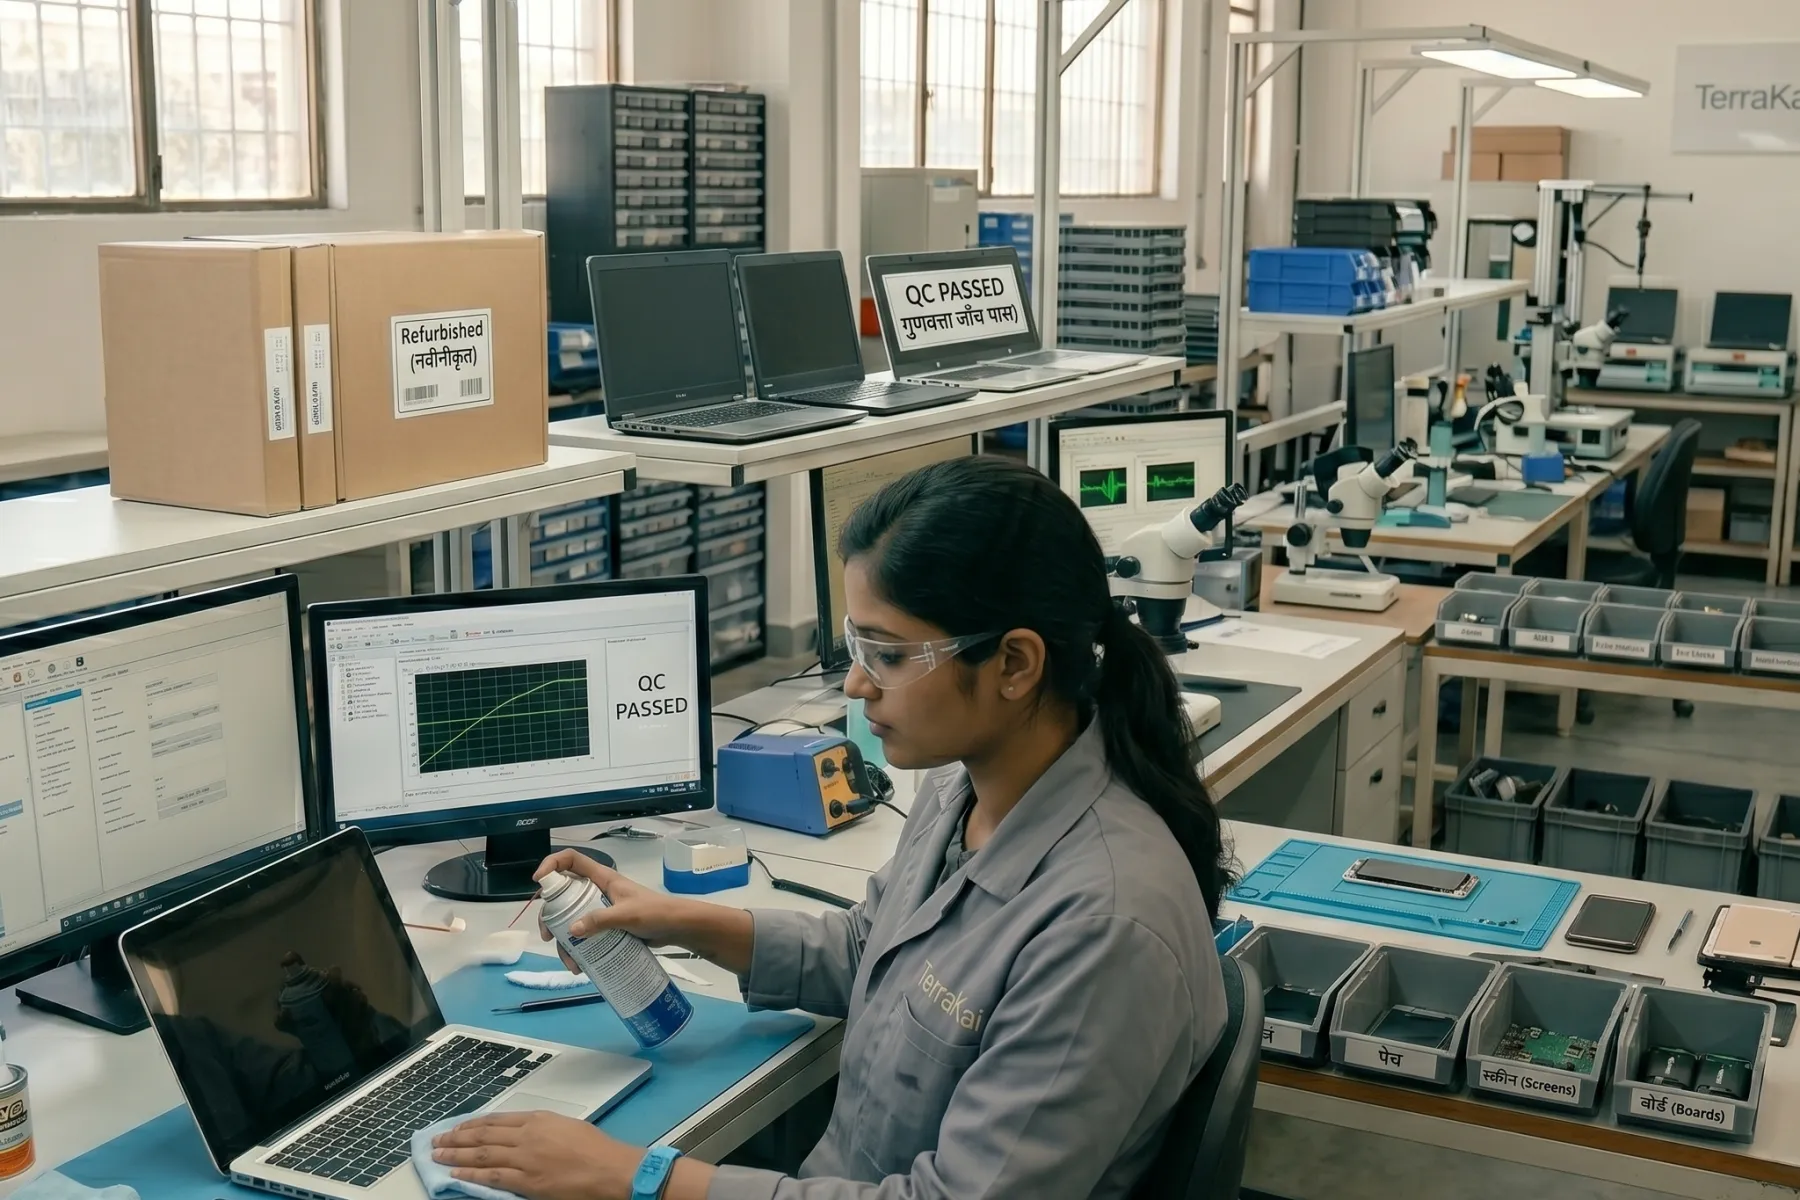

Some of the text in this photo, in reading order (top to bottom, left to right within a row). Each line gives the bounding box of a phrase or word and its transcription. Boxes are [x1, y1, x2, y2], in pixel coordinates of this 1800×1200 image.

[905, 277, 1004, 307] QC PASSED
[401, 320, 483, 345] Refurbished
[900, 312, 953, 340] गुणवत्ता
[987, 304, 1018, 324] पास)
[410, 345, 477, 374] (नवीनीकृत)
[638, 673, 666, 692] QC
[616, 697, 688, 720] PASSED
[918, 959, 984, 1032] TerraKai
[1378, 1045, 1404, 1067] पेच
[1520, 1076, 1576, 1098] (Screens)
[1671, 1102, 1725, 1124] (Boards)
